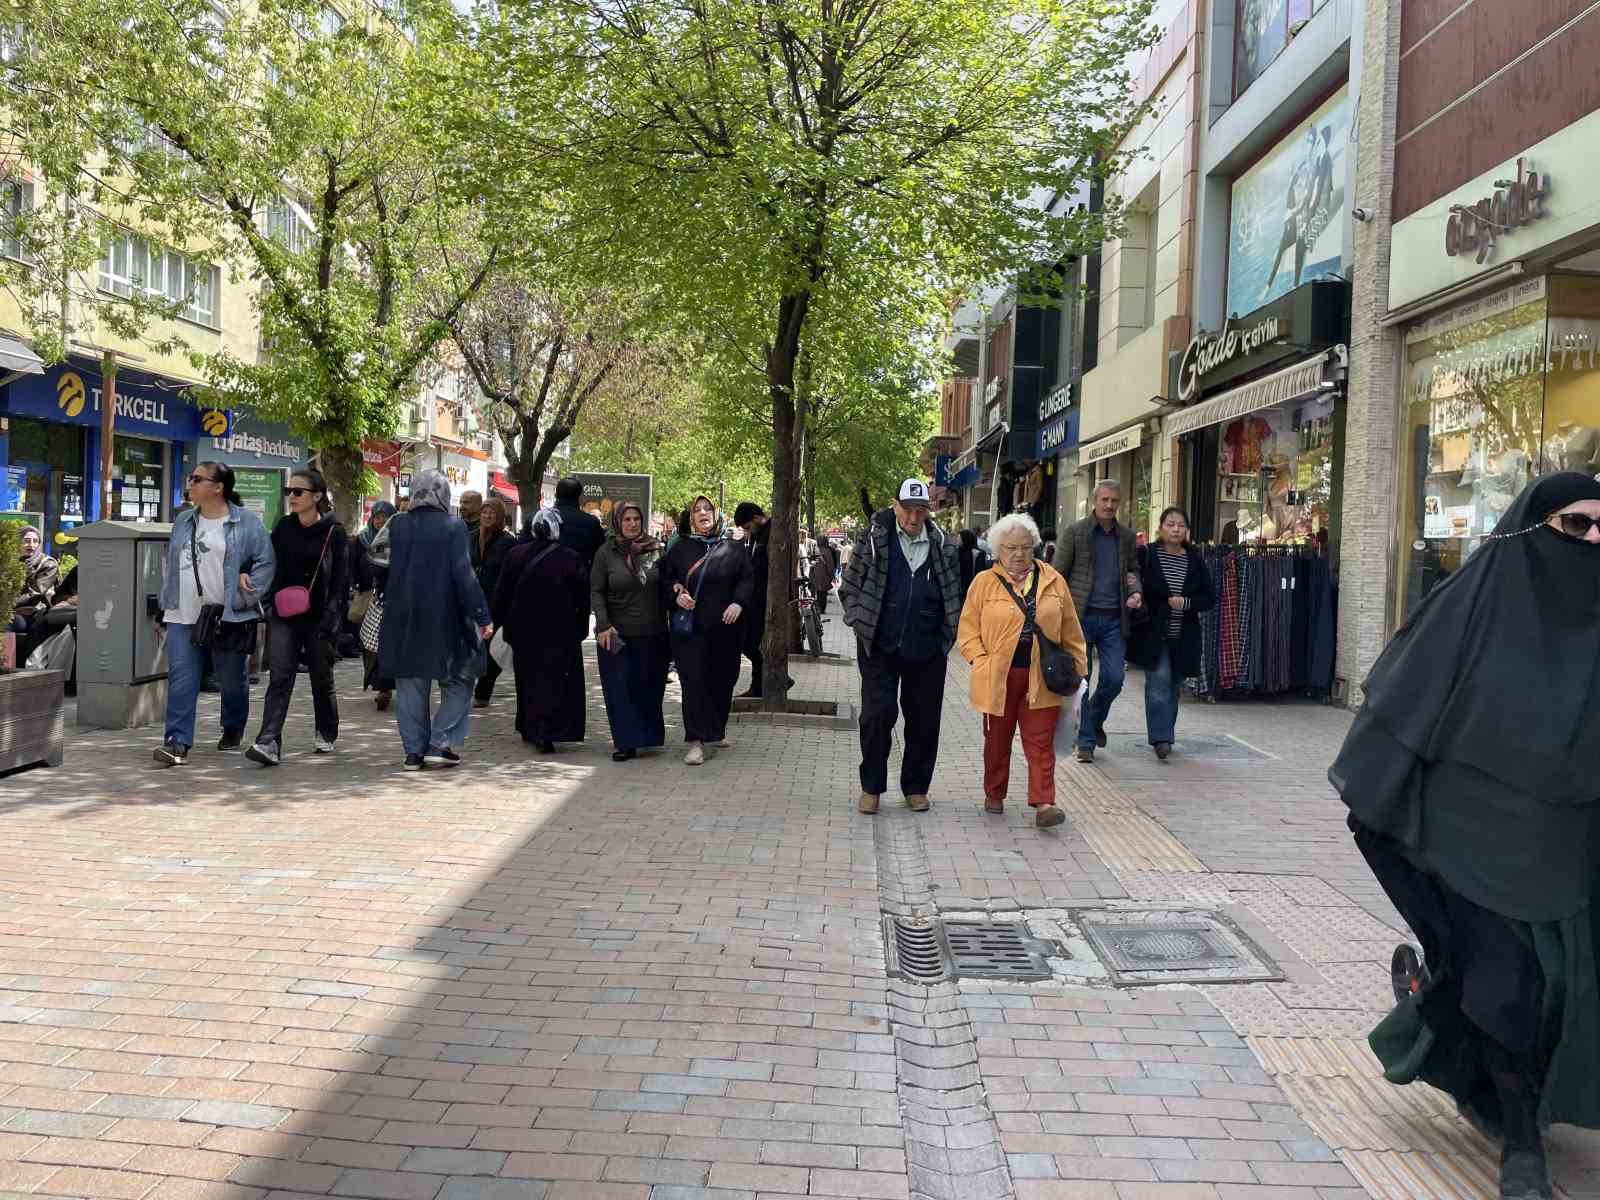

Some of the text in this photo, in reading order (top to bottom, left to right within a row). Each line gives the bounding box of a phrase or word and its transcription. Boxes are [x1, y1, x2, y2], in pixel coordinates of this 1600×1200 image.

[1178, 318, 1239, 400] Gözde
[91, 387, 169, 425] TRKCELL
[262, 436, 300, 463] bedding
[1042, 430, 1047, 450] G
[1047, 419, 1065, 448] MANN
